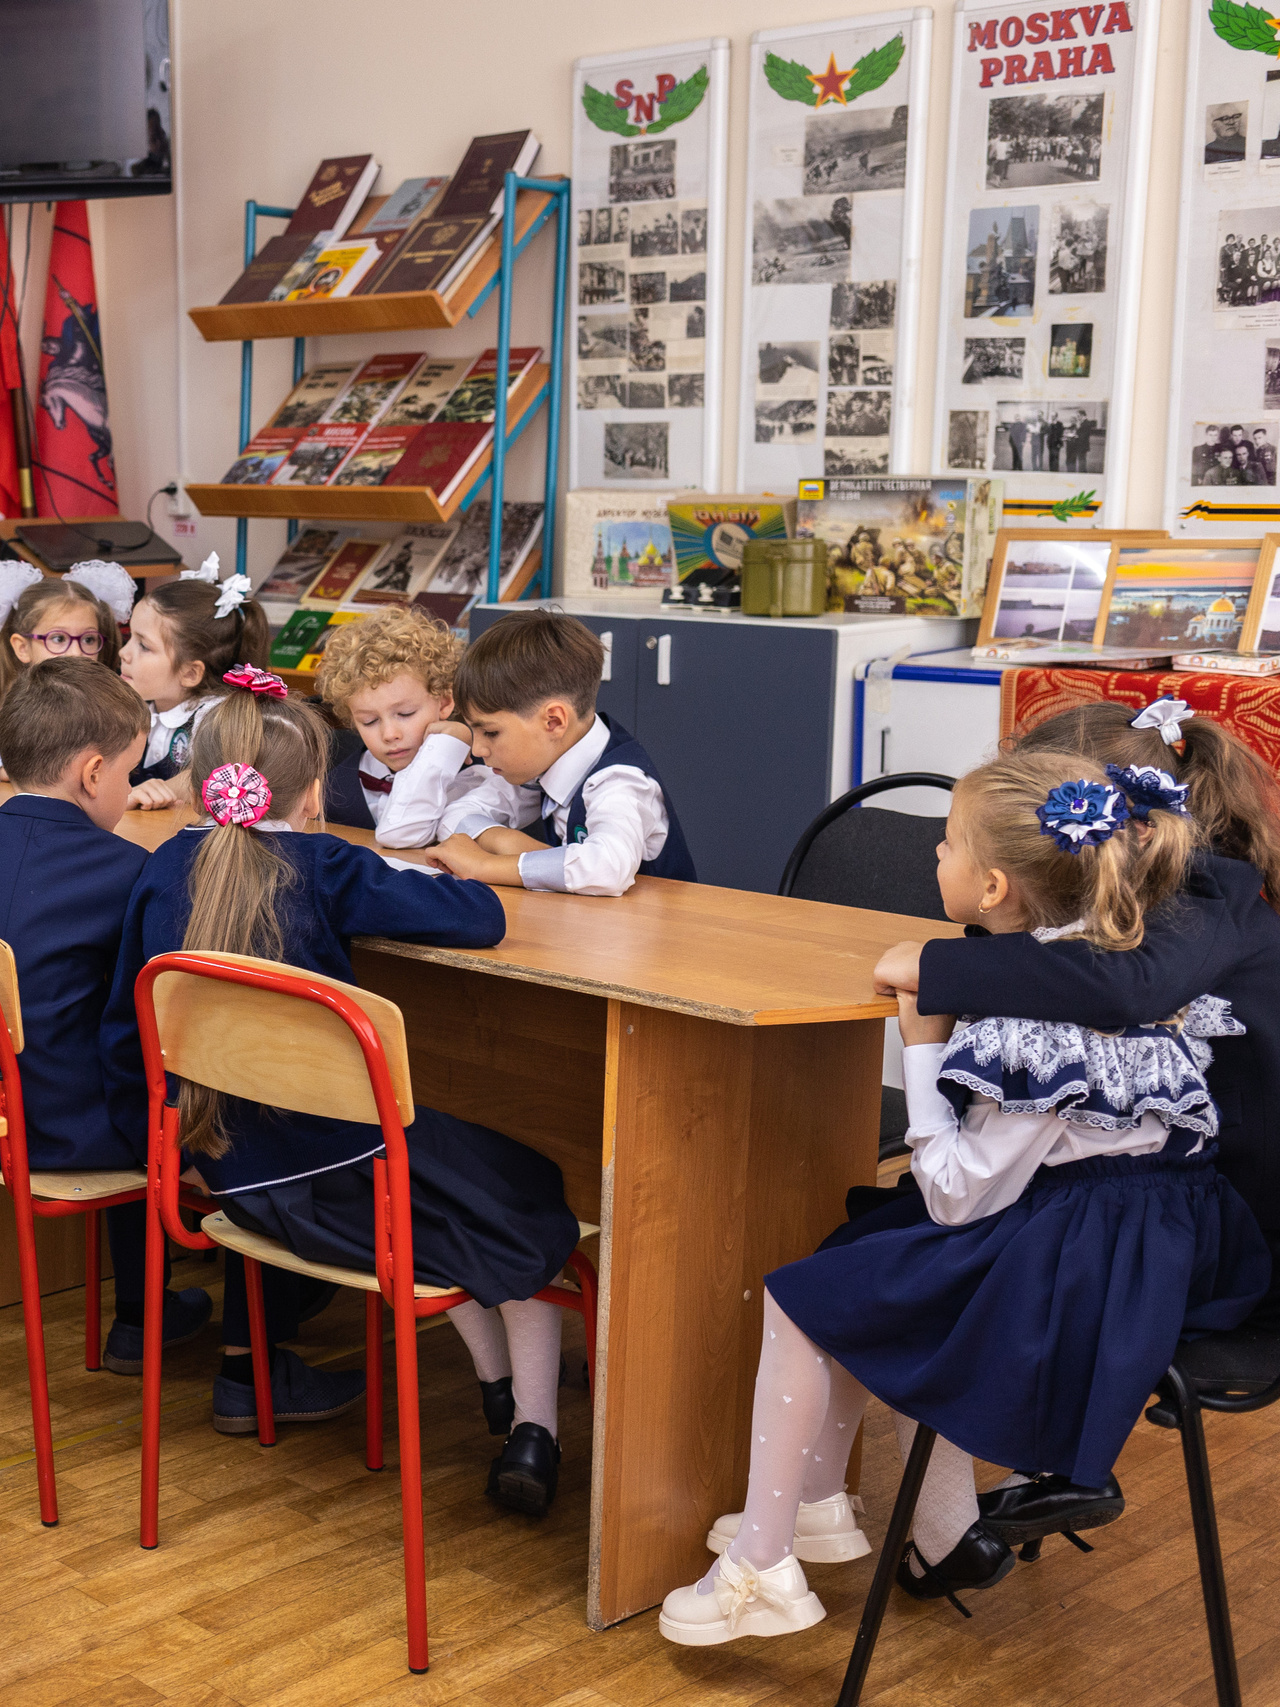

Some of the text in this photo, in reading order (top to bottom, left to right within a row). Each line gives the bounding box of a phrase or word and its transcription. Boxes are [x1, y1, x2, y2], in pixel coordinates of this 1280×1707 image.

[967, 1, 1133, 52] MOSKVA
[979, 43, 1115, 87] PRAHA
[614, 73, 677, 123] SNP
